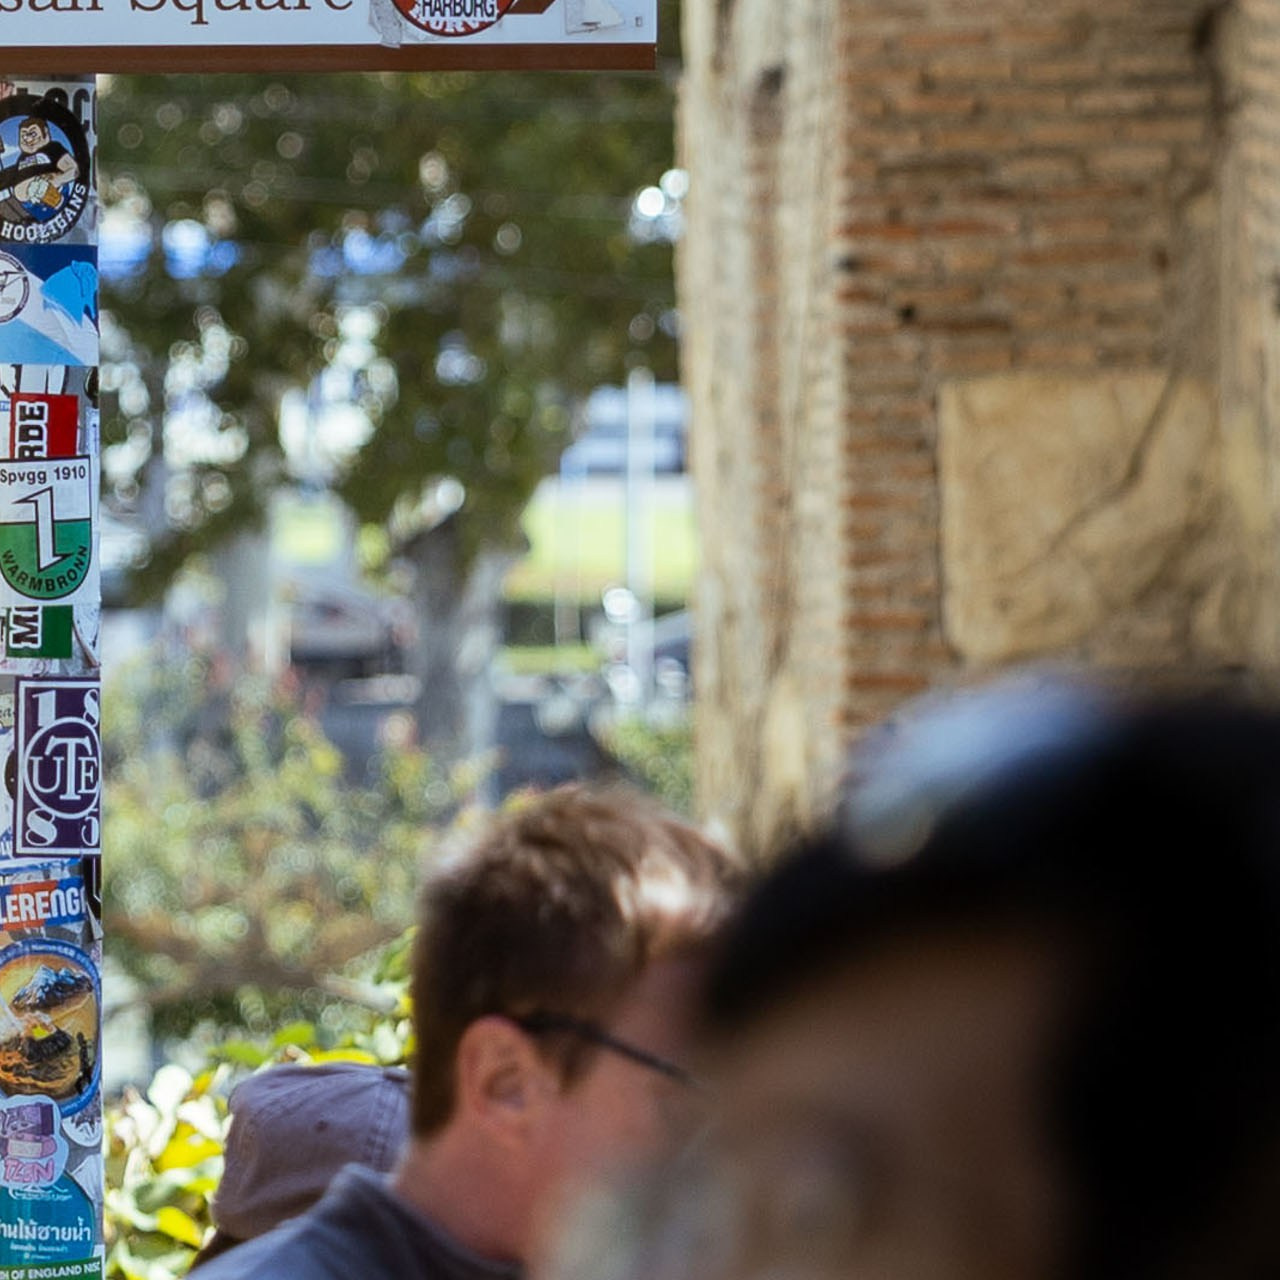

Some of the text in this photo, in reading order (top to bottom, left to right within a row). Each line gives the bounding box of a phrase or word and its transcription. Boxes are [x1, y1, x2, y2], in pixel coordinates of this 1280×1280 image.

[0, 182, 87, 242] HOOLIGANS
[0, 465, 86, 484] Spvgg 1910
[0, 546, 89, 592] WARMBRONN
[11, 1269, 25, 1280] OF
[28, 1266, 82, 1280] ENGLAND
